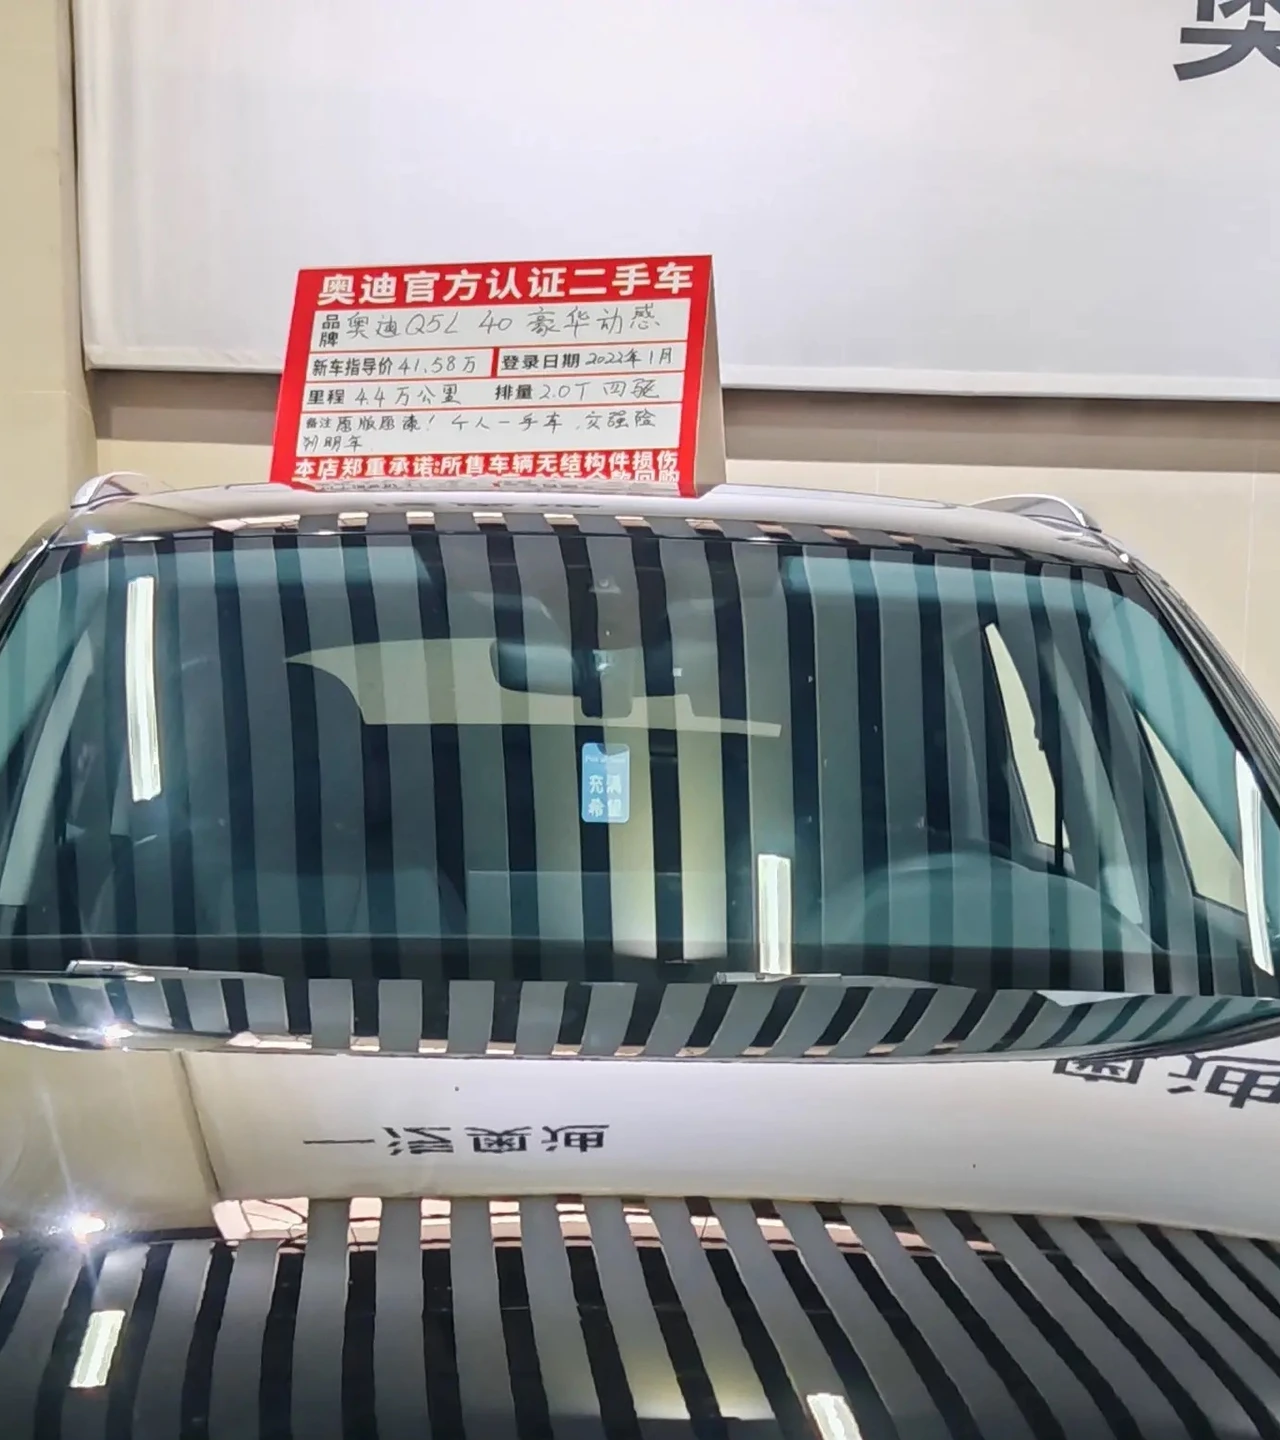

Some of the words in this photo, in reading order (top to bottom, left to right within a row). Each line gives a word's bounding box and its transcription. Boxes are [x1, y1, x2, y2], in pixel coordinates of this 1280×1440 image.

[318, 262, 694, 305] 奥迪官方认证二手车
[479, 308, 513, 335] 40
[312, 357, 393, 377] 新车指导价
[501, 353, 580, 371] 登录日期
[307, 389, 345, 405] 里程
[495, 384, 533, 401] 排量
